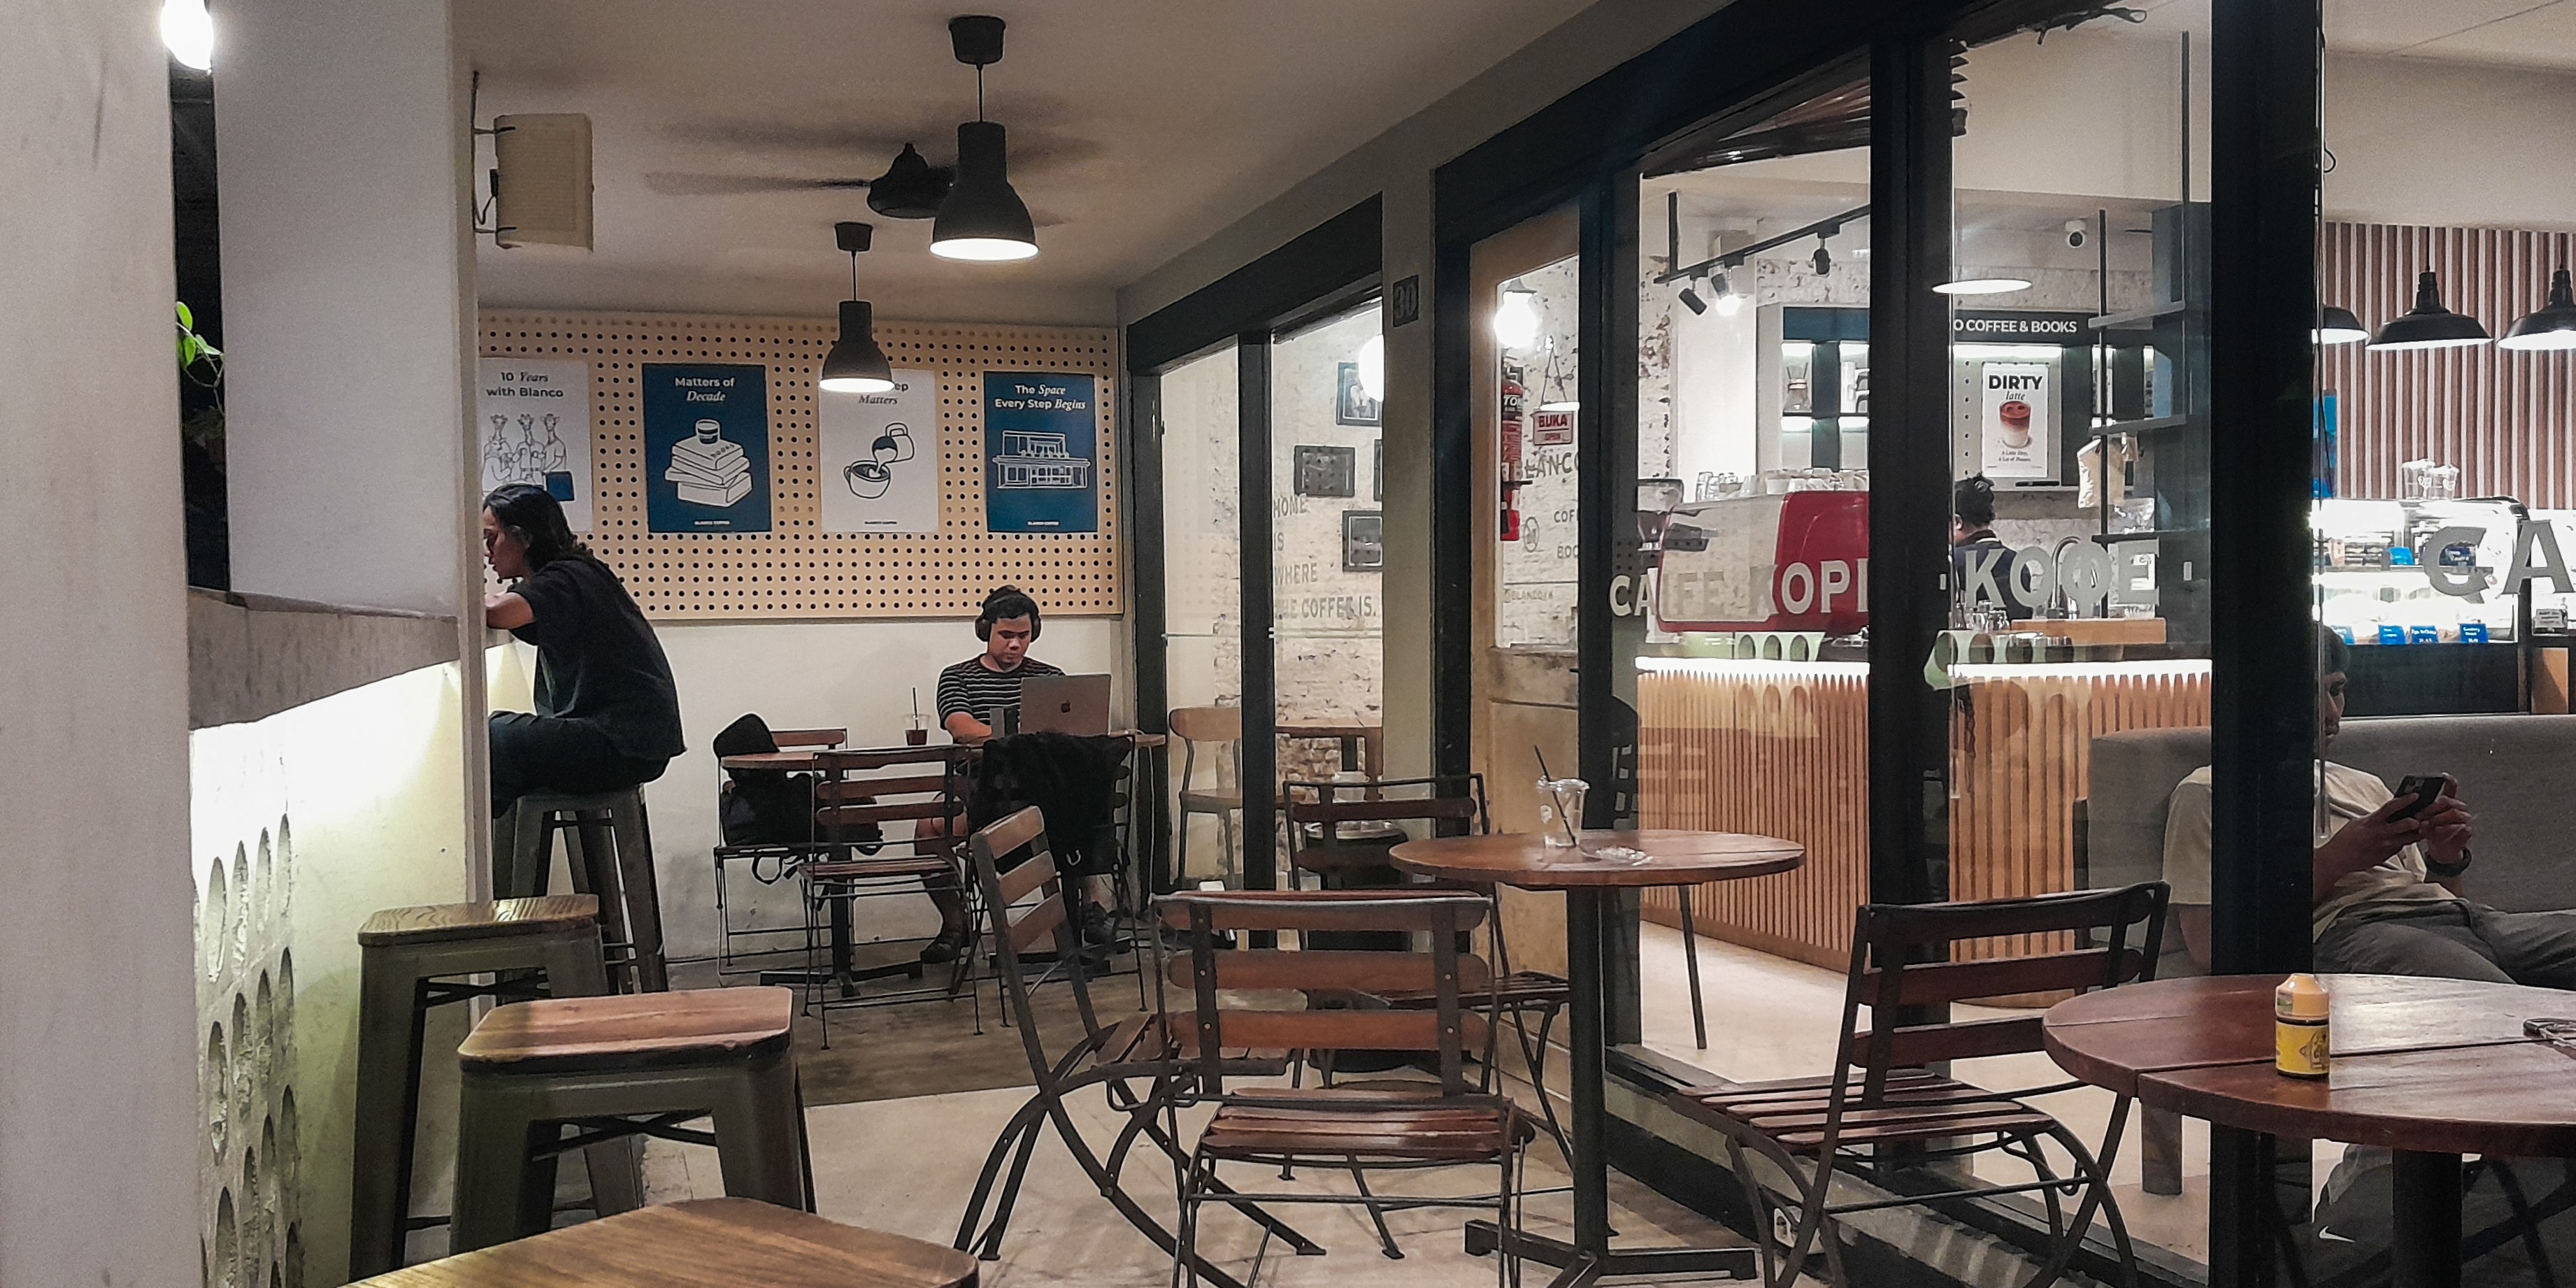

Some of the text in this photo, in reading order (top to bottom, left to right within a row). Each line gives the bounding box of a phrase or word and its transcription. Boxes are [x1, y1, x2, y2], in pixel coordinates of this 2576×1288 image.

[1966, 319, 2018, 333] COFFEE
[2019, 320, 2028, 333] &
[2031, 321, 2077, 333] BOOKS
[501, 371, 548, 382] 10 Years
[675, 377, 735, 387] Matters of
[1989, 375, 2042, 390] DIRTY
[486, 387, 564, 397] with Blanco
[687, 390, 726, 401] Decade
[1015, 384, 1066, 396] The Space
[2005, 391, 2026, 401] latte
[859, 394, 898, 405] Matters
[994, 399, 1086, 411] Every Step Begins
[1538, 414, 1568, 427] BUKA
[1273, 494, 1308, 518] HOME
[1554, 509, 1579, 522] COF
[1274, 532, 1285, 552] IS
[1275, 562, 1318, 586] WHERE
[1749, 558, 1868, 615] KOPI
[1302, 596, 1354, 619] COFFEE
[1359, 596, 1377, 617] IS.
